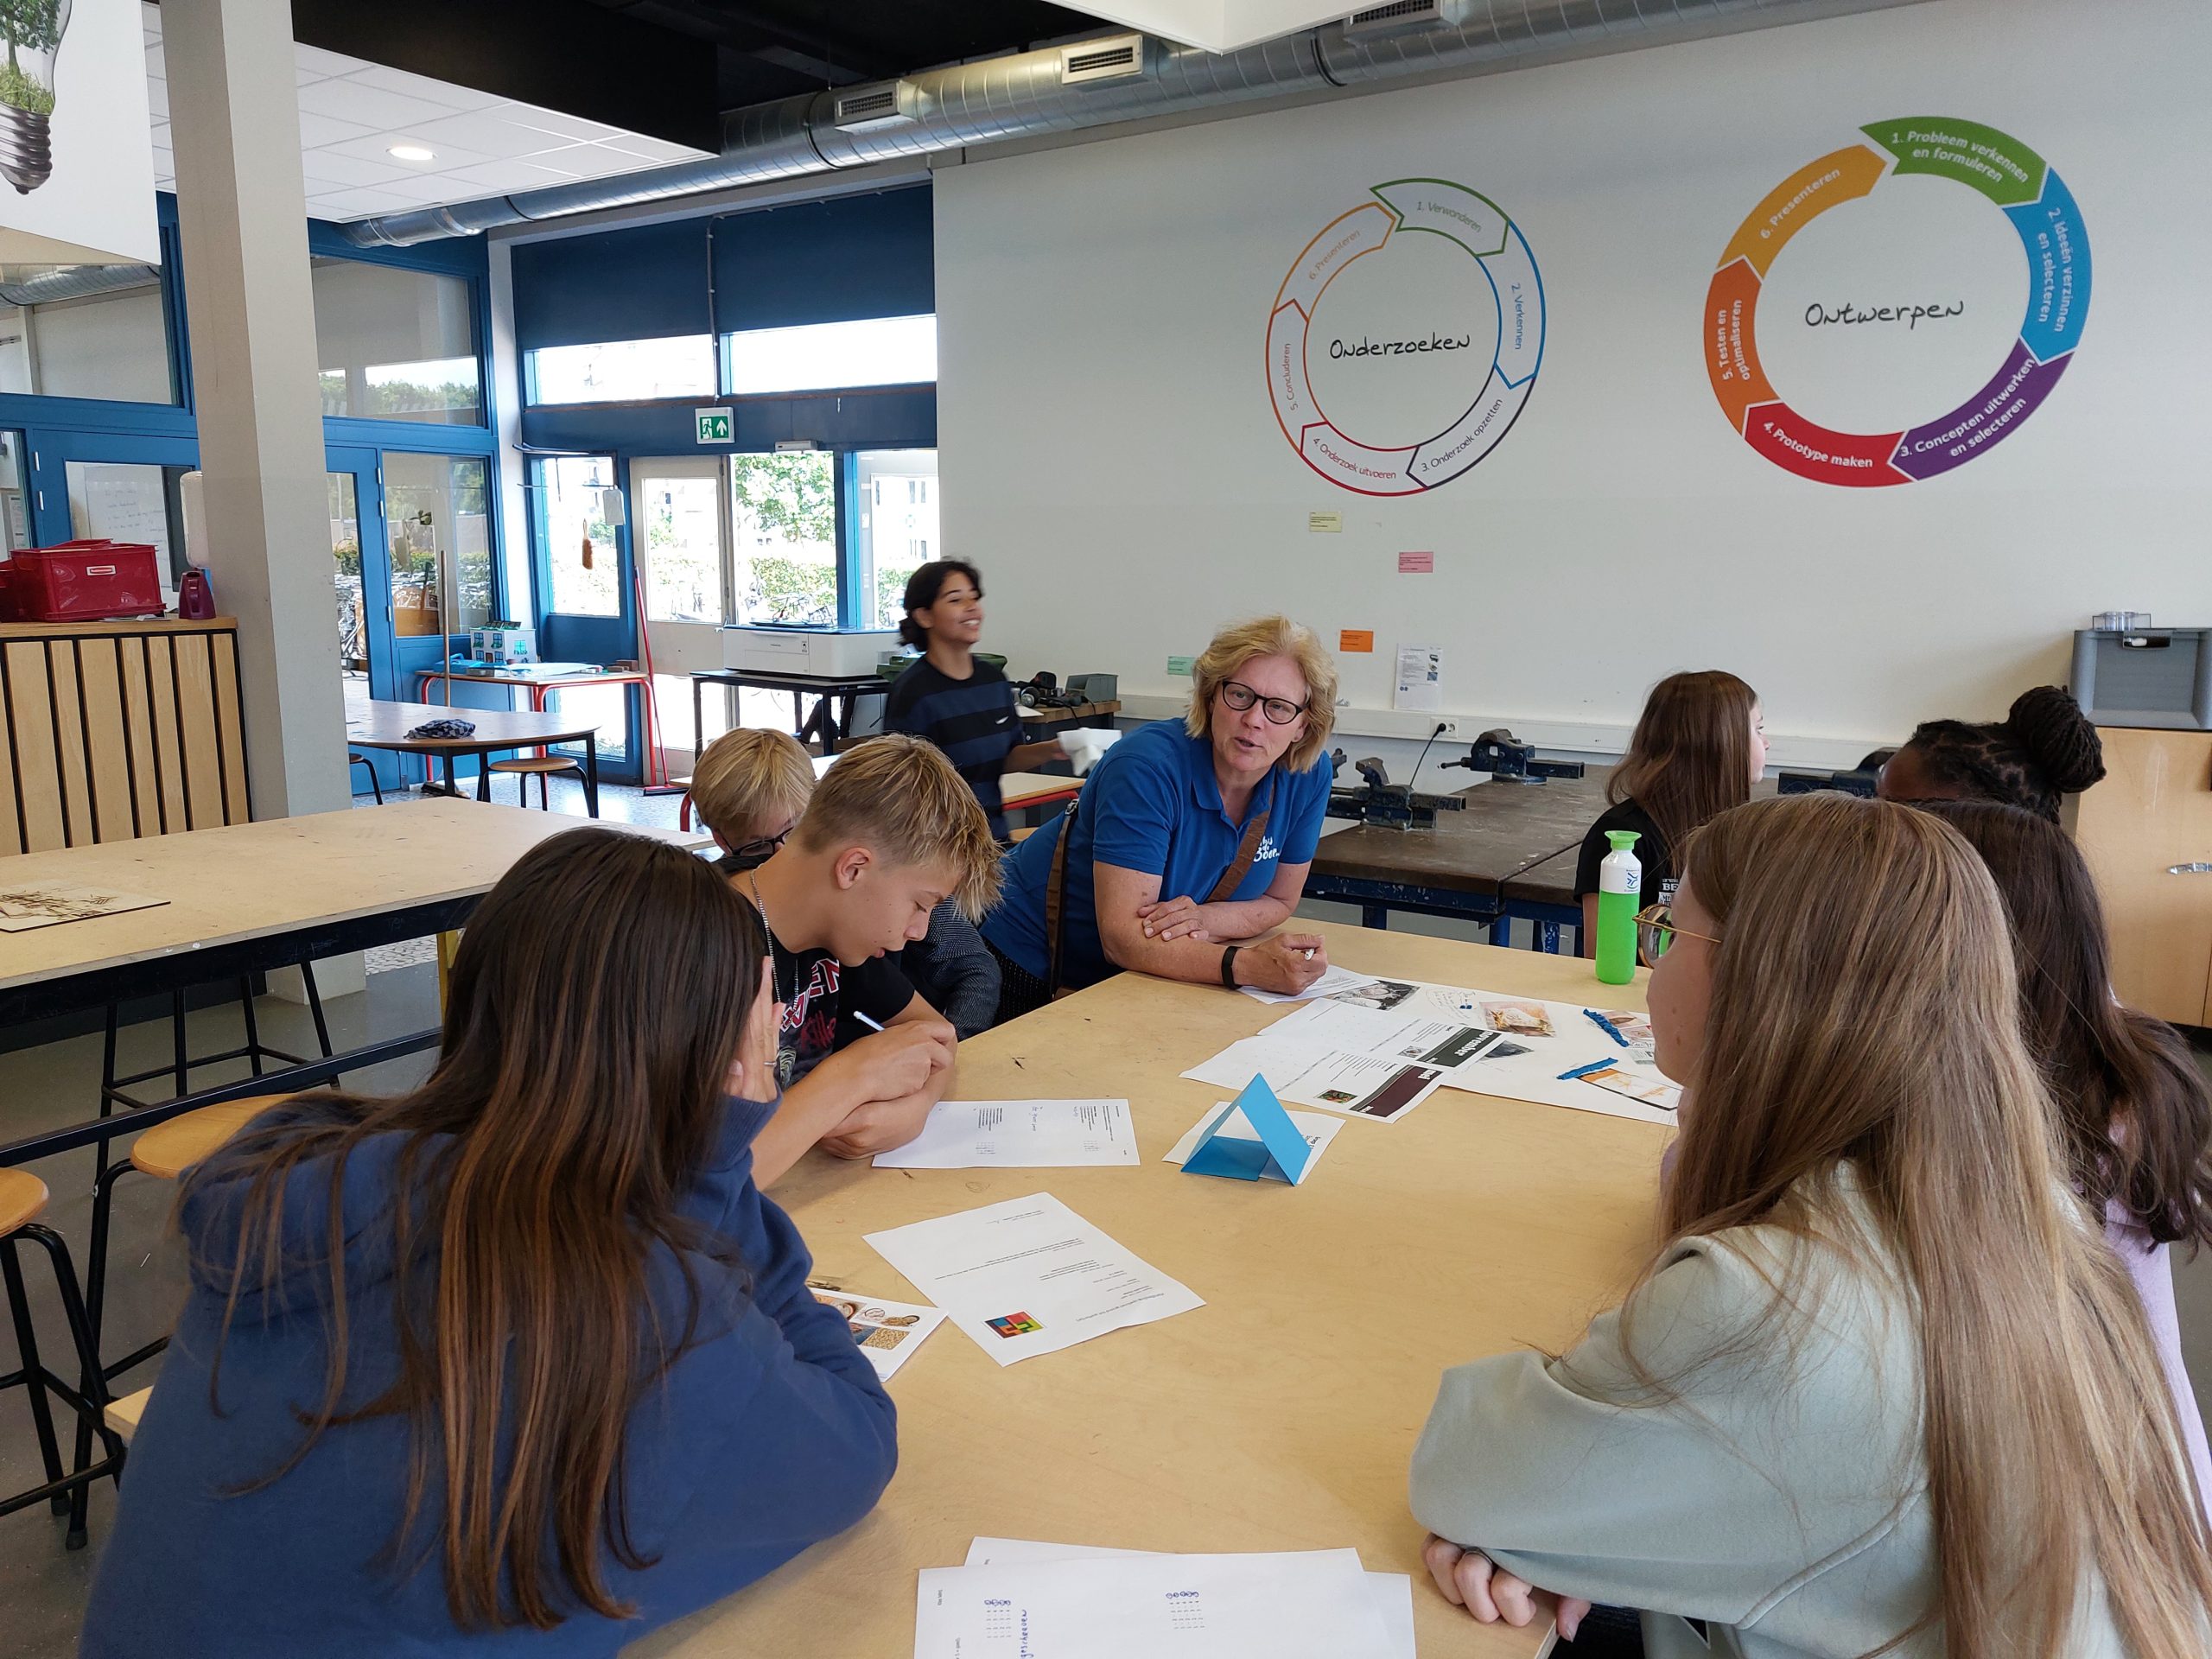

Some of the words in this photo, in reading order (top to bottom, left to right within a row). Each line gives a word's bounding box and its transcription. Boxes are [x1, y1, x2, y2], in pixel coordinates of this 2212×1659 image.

[1891, 132, 1904, 143] 1.
[1907, 130, 1968, 149] Probleem
[1971, 143, 2029, 182] verkennen
[1913, 148, 1929, 158] en
[1933, 147, 2003, 182] formuleren
[1417, 200, 1426, 211] 1.
[1427, 201, 1482, 232] Verwonderen
[1760, 227, 1774, 239] 6.
[1770, 168, 1840, 226] Presenteren
[1308, 269, 1318, 281] 6.
[1314, 230, 1361, 272] Presenteren
[2037, 232, 2050, 249] en
[2054, 221, 2073, 264] Ideeën
[2038, 251, 2056, 322] selecteren
[2054, 266, 2073, 332] verzinnen
[1515, 295, 1525, 350] Verkennen
[1718, 309, 1727, 321] en
[1804, 300, 1964, 330] Ontwerpen
[1329, 331, 1471, 359] Onderzoeken
[1717, 328, 1729, 368] Testen
[1731, 299, 1751, 380] optimaliseren
[1282, 343, 1294, 401] Concluderen
[1722, 368, 1733, 380] 5.
[1900, 445, 1912, 456] 3.
[1915, 413, 1985, 453] Concepten
[1984, 357, 2036, 415] uitwerken
[1949, 444, 1967, 457] en
[1969, 397, 2027, 448] selecteren
[1422, 462, 1430, 472] 3.
[1431, 435, 1474, 467] Onderzoek
[1474, 398, 1503, 437] opzetten
[1764, 421, 1775, 434] 4.
[1773, 428, 1828, 462] Prototype
[1831, 454, 1872, 467] maken
[1313, 437, 1320, 447] 4.
[1319, 443, 1358, 473] Onderzoek
[1359, 467, 1396, 480] uitvoeren
[1454, 1030, 1494, 1057] november
